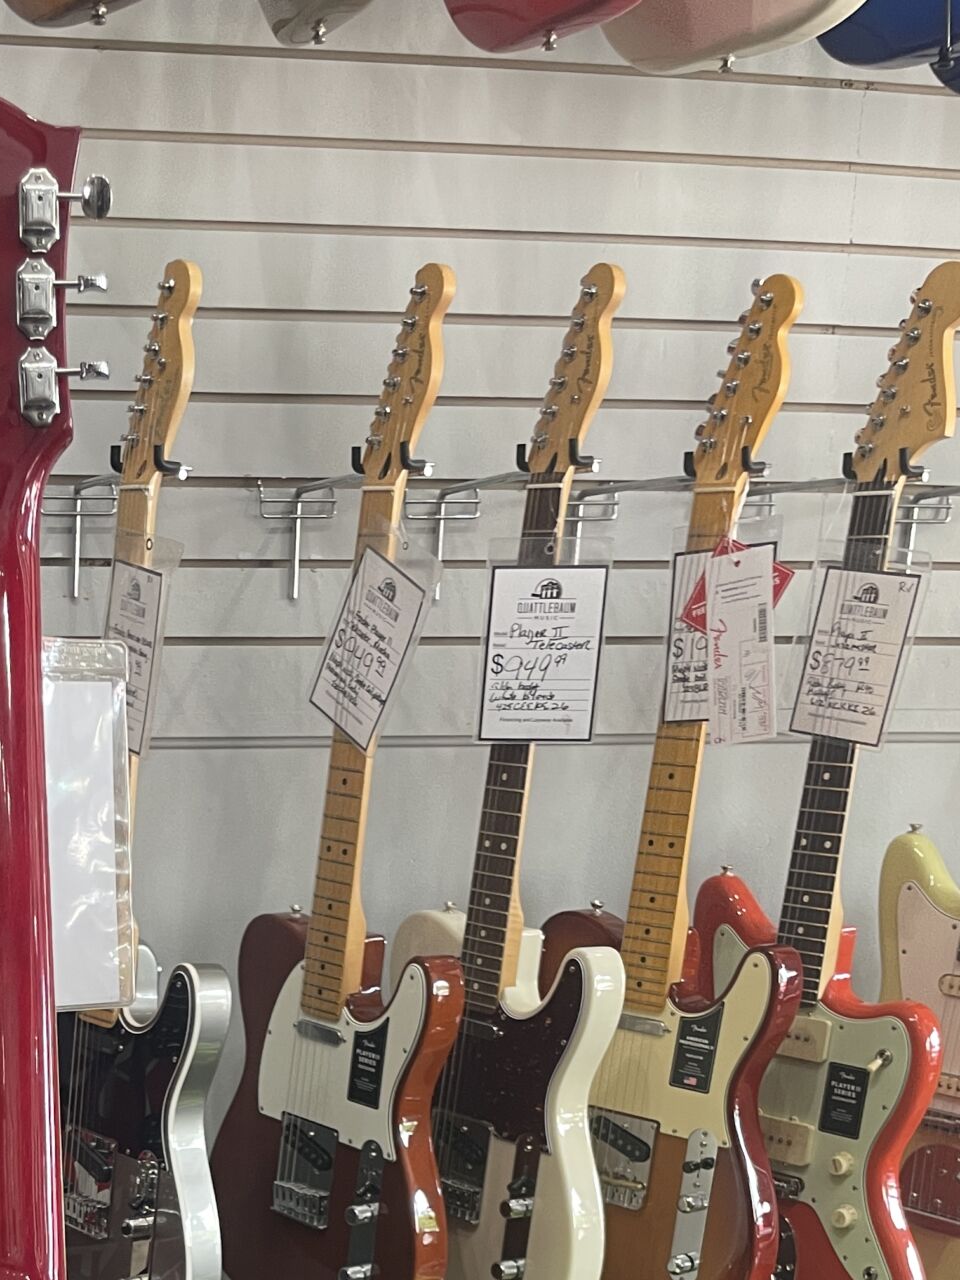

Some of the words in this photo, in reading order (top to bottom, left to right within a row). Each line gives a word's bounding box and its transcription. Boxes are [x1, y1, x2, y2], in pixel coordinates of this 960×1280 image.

[920, 362, 941, 416] Fender
[517, 602, 576, 614] QUATTLEBAUM
[710, 618, 728, 670] Fender
